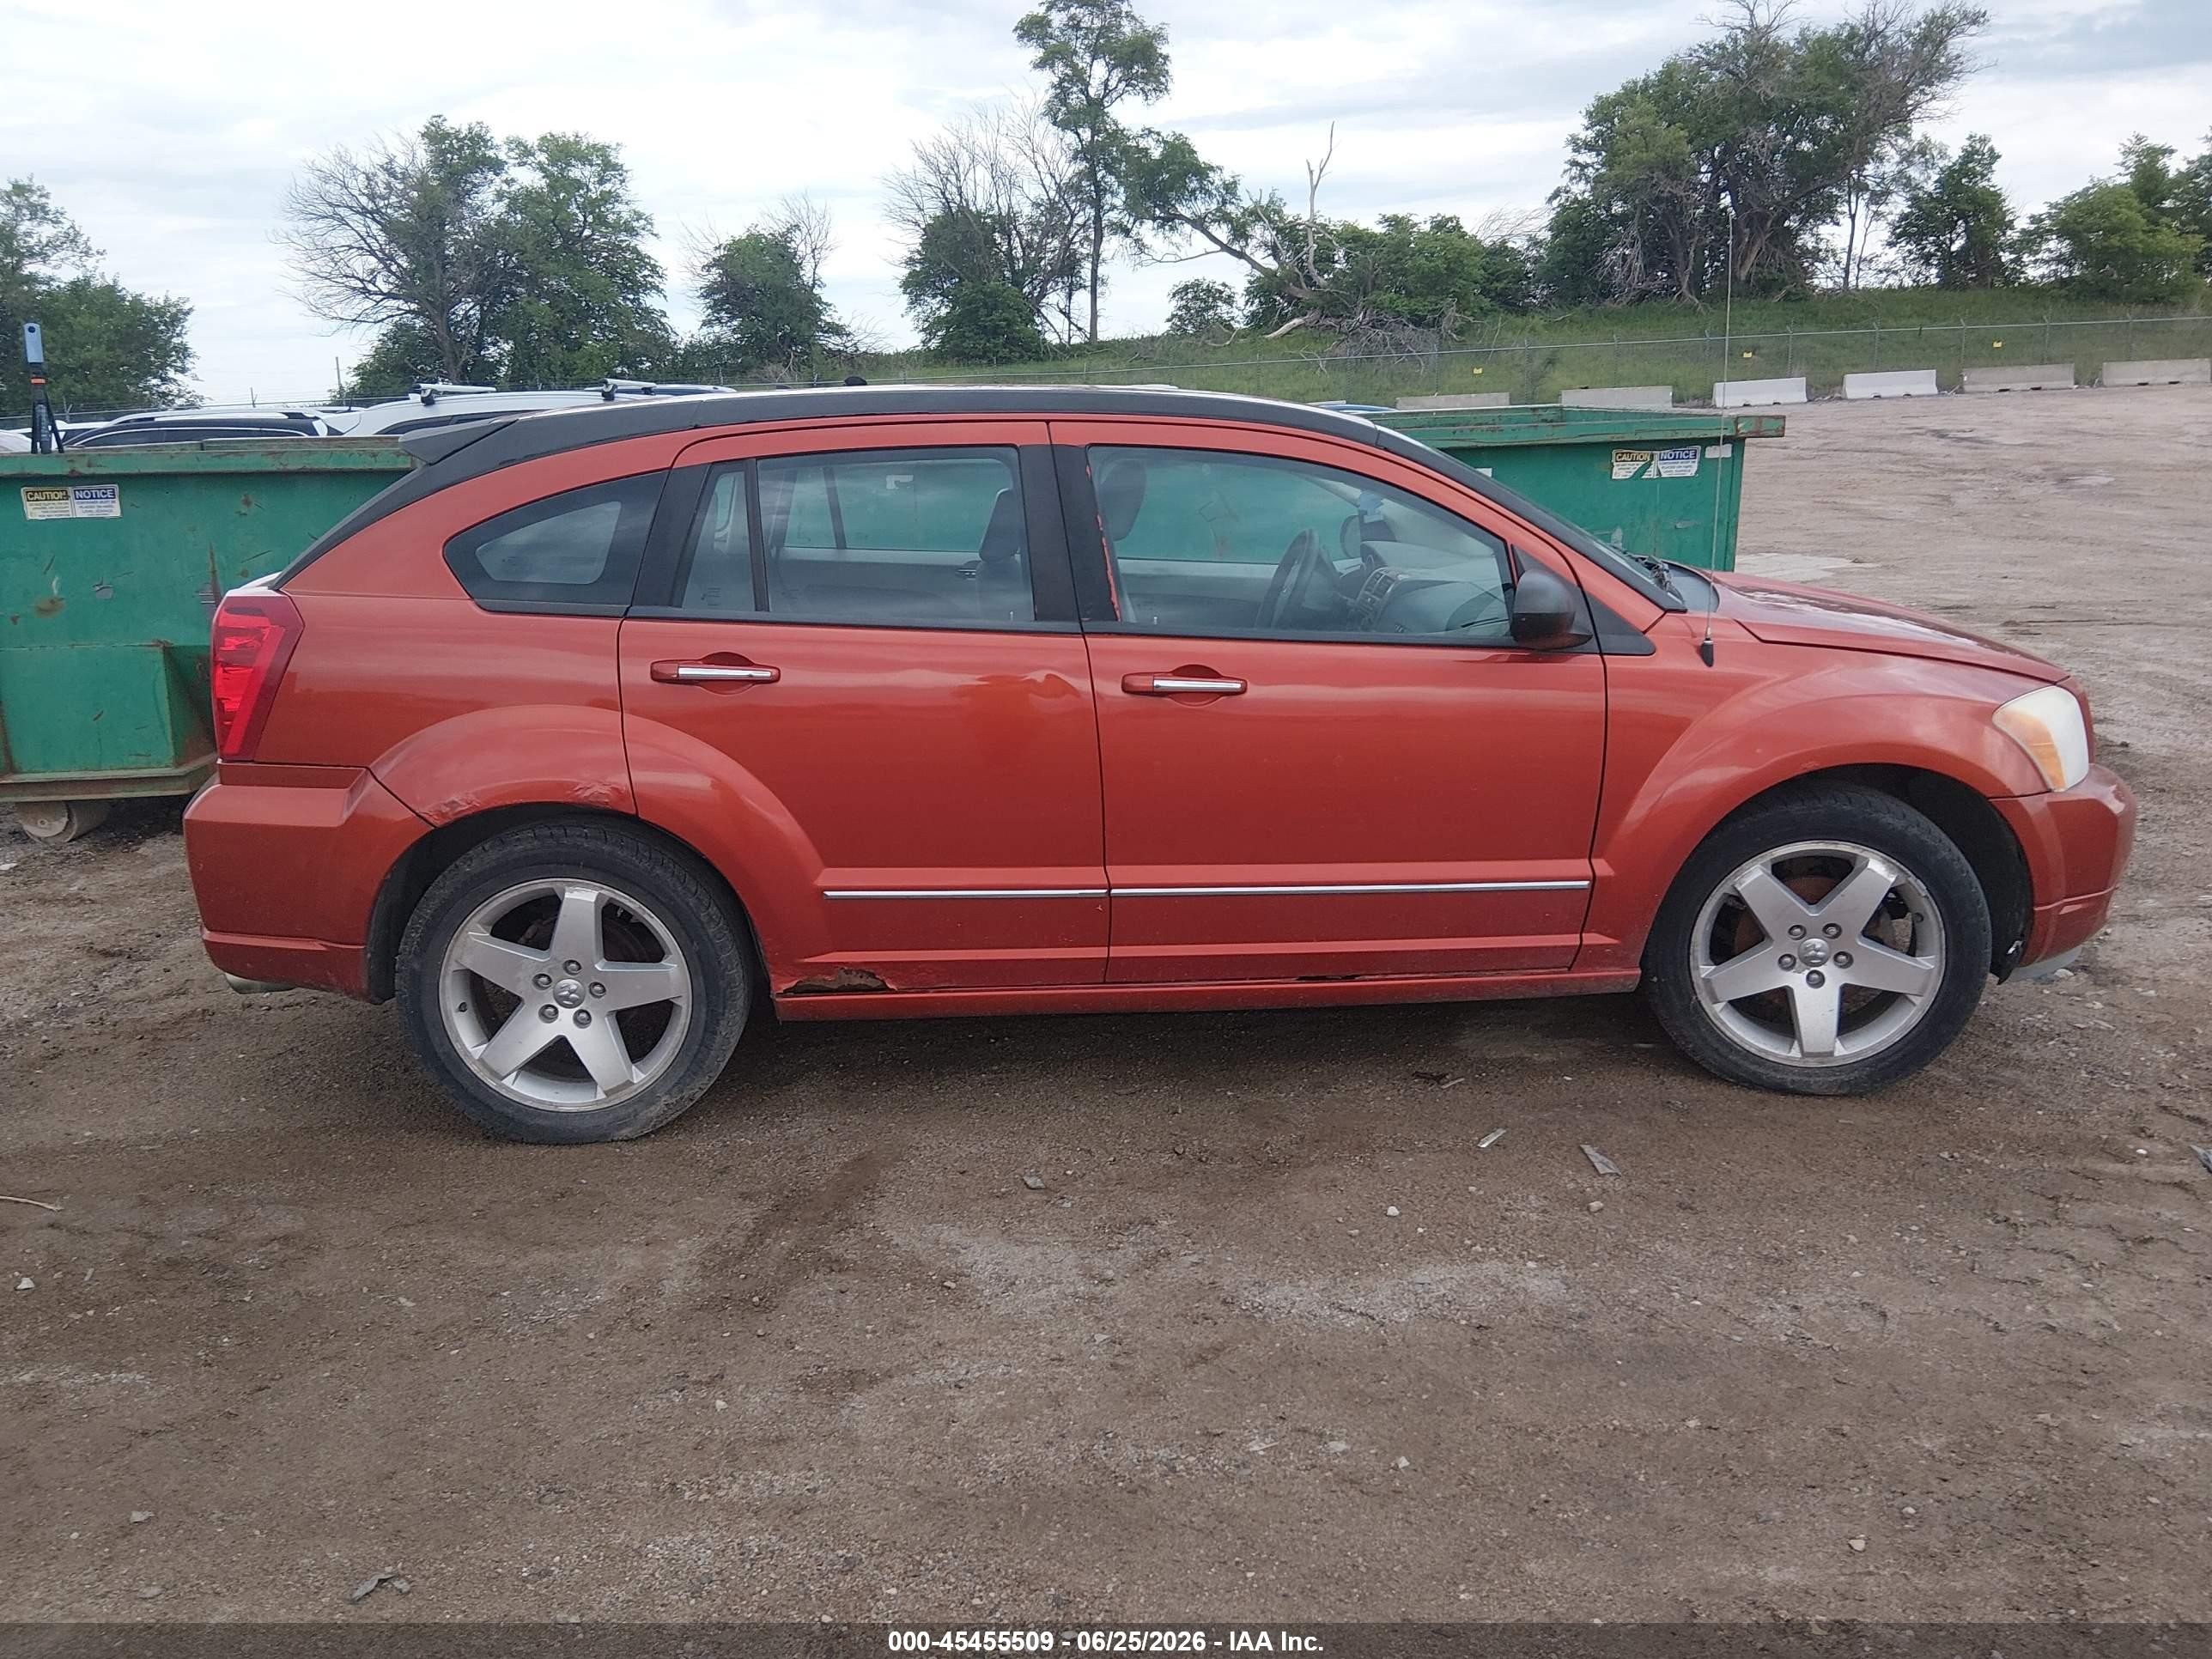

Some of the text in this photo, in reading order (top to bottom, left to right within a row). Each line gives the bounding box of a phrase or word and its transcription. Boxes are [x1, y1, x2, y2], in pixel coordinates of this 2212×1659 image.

[1616, 453, 1650, 461] CAUTION
[1660, 450, 1696, 460] NOTICE
[27, 490, 66, 501] CAUTION
[76, 489, 114, 499] NOTICE
